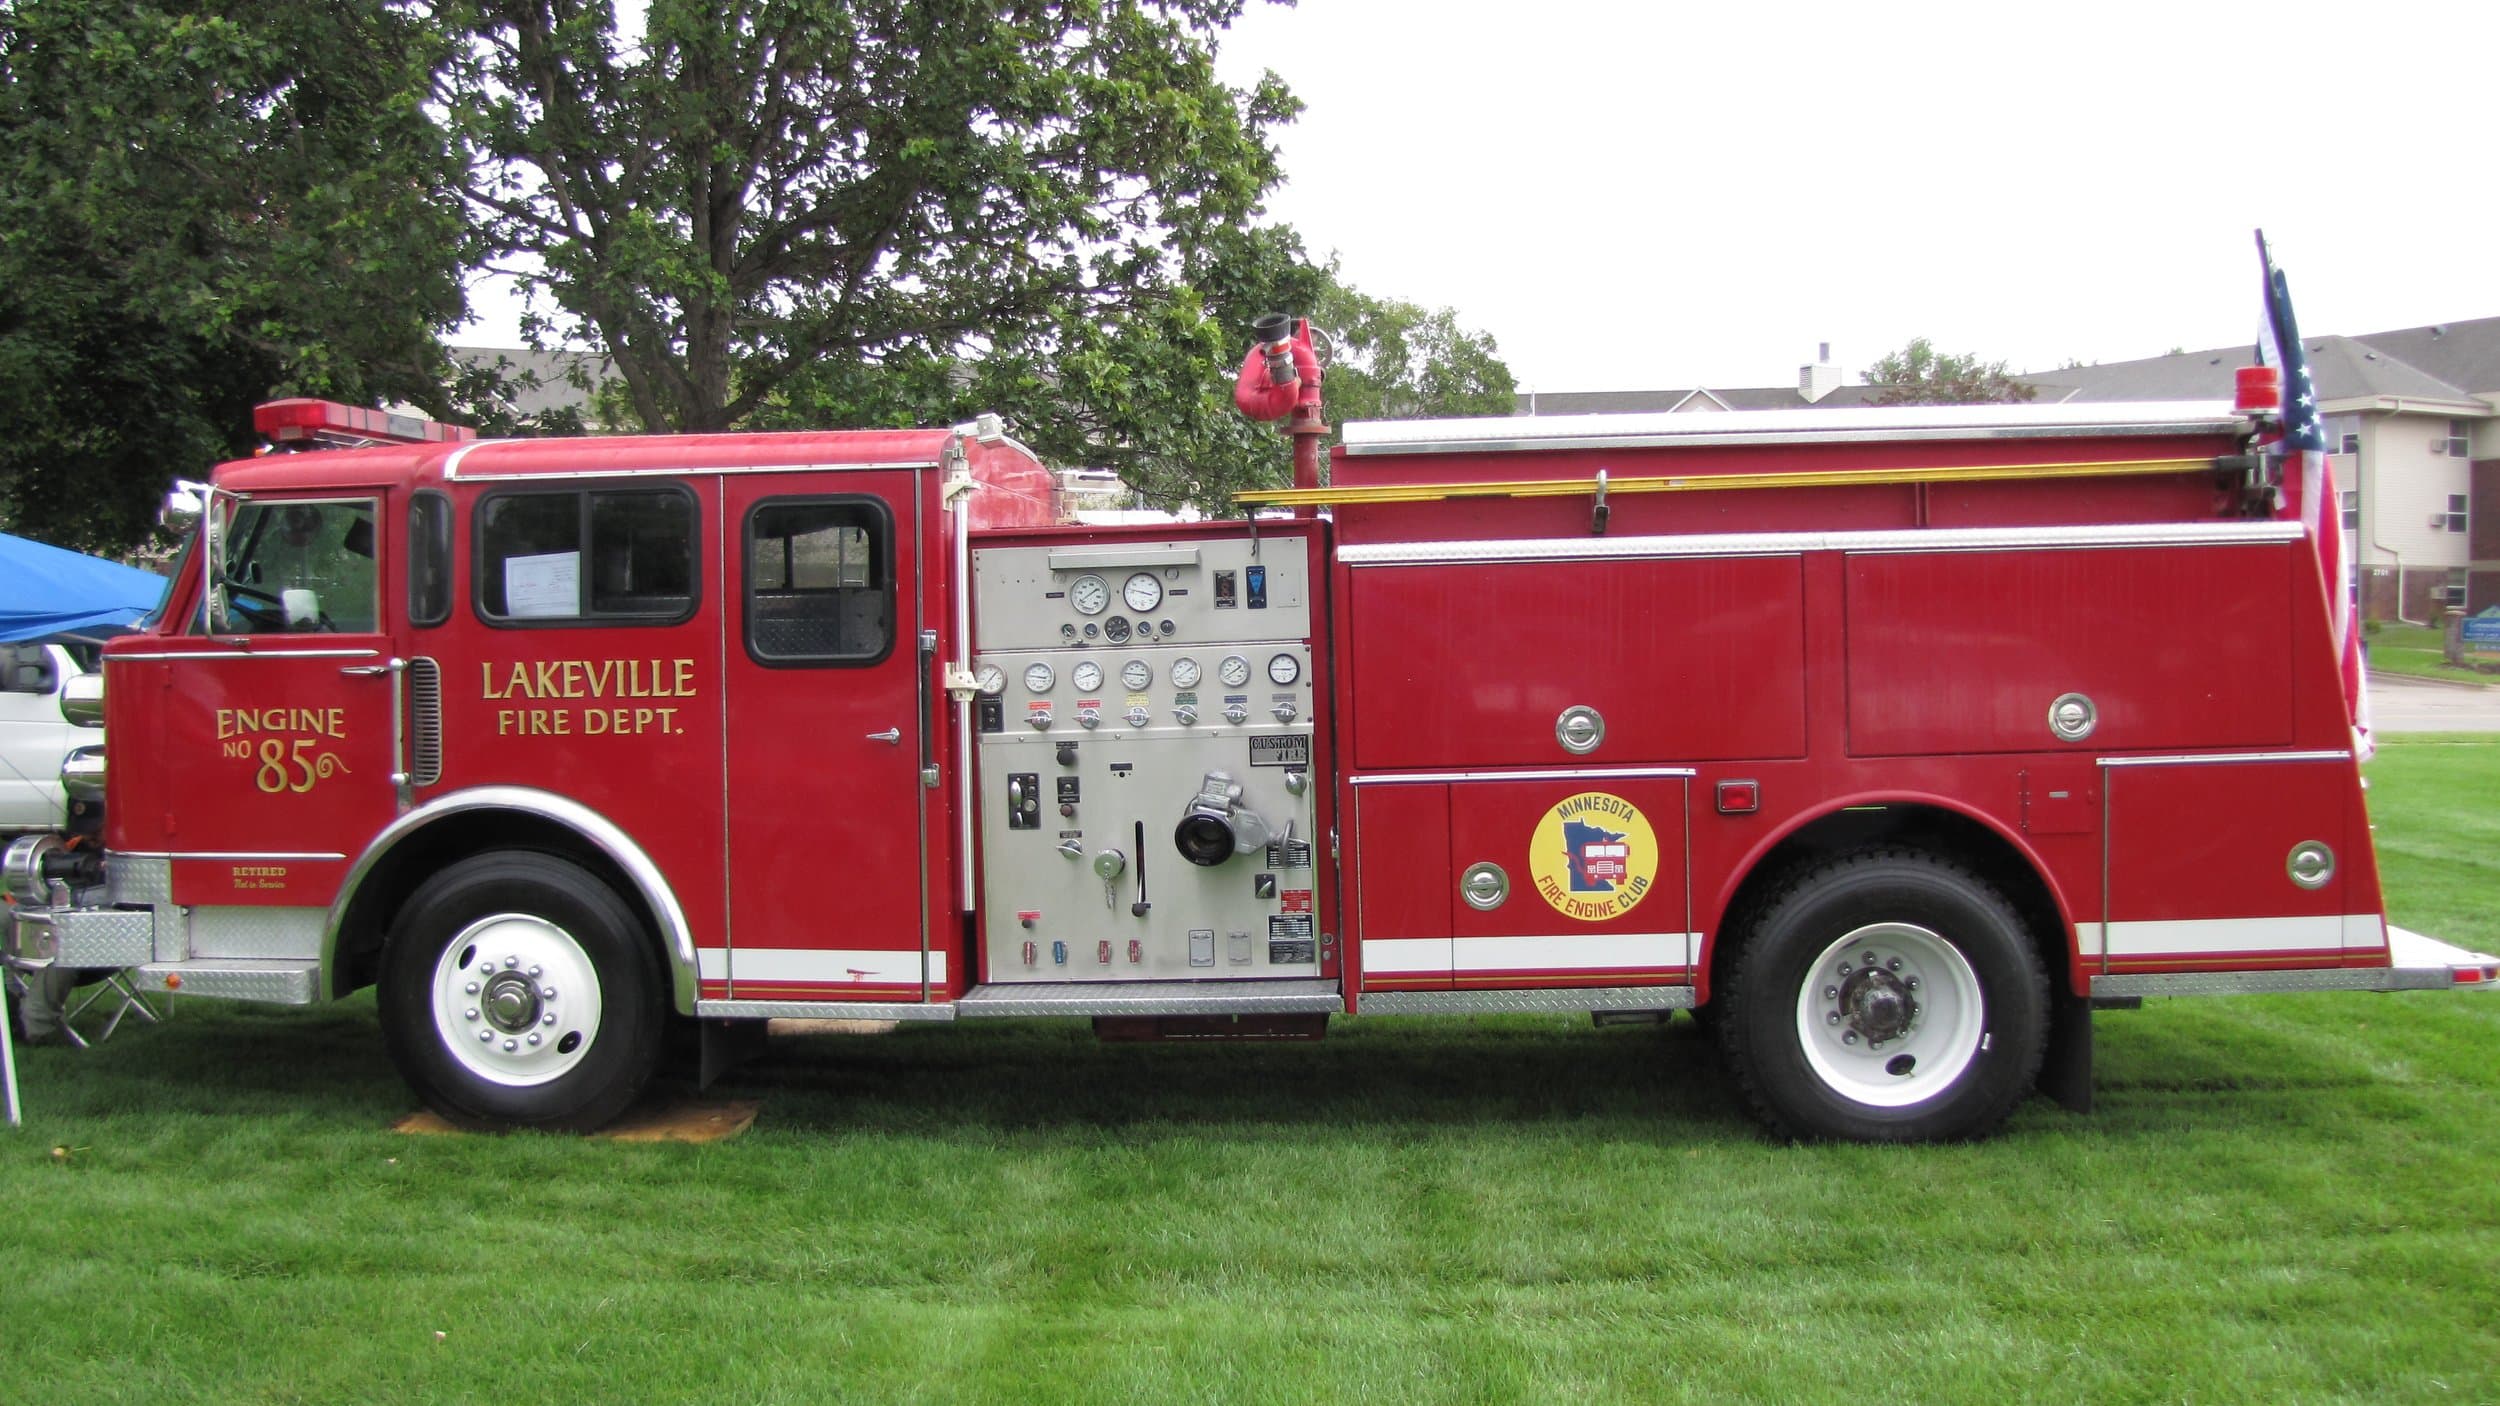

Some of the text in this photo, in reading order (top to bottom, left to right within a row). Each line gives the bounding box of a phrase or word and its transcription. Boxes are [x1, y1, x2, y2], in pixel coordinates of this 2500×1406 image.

[481, 658, 698, 701] LAKEVILLE
[216, 707, 346, 740] ENGINE
[498, 707, 685, 737] FIRE DEPT.
[1252, 737, 1304, 749] CUSTOM
[223, 739, 316, 793] NO 85
[1557, 797, 1634, 823] MINNESOTA
[233, 867, 286, 876] RETIRED
[1538, 875, 1648, 918] FIRE ENGINE CLUB
